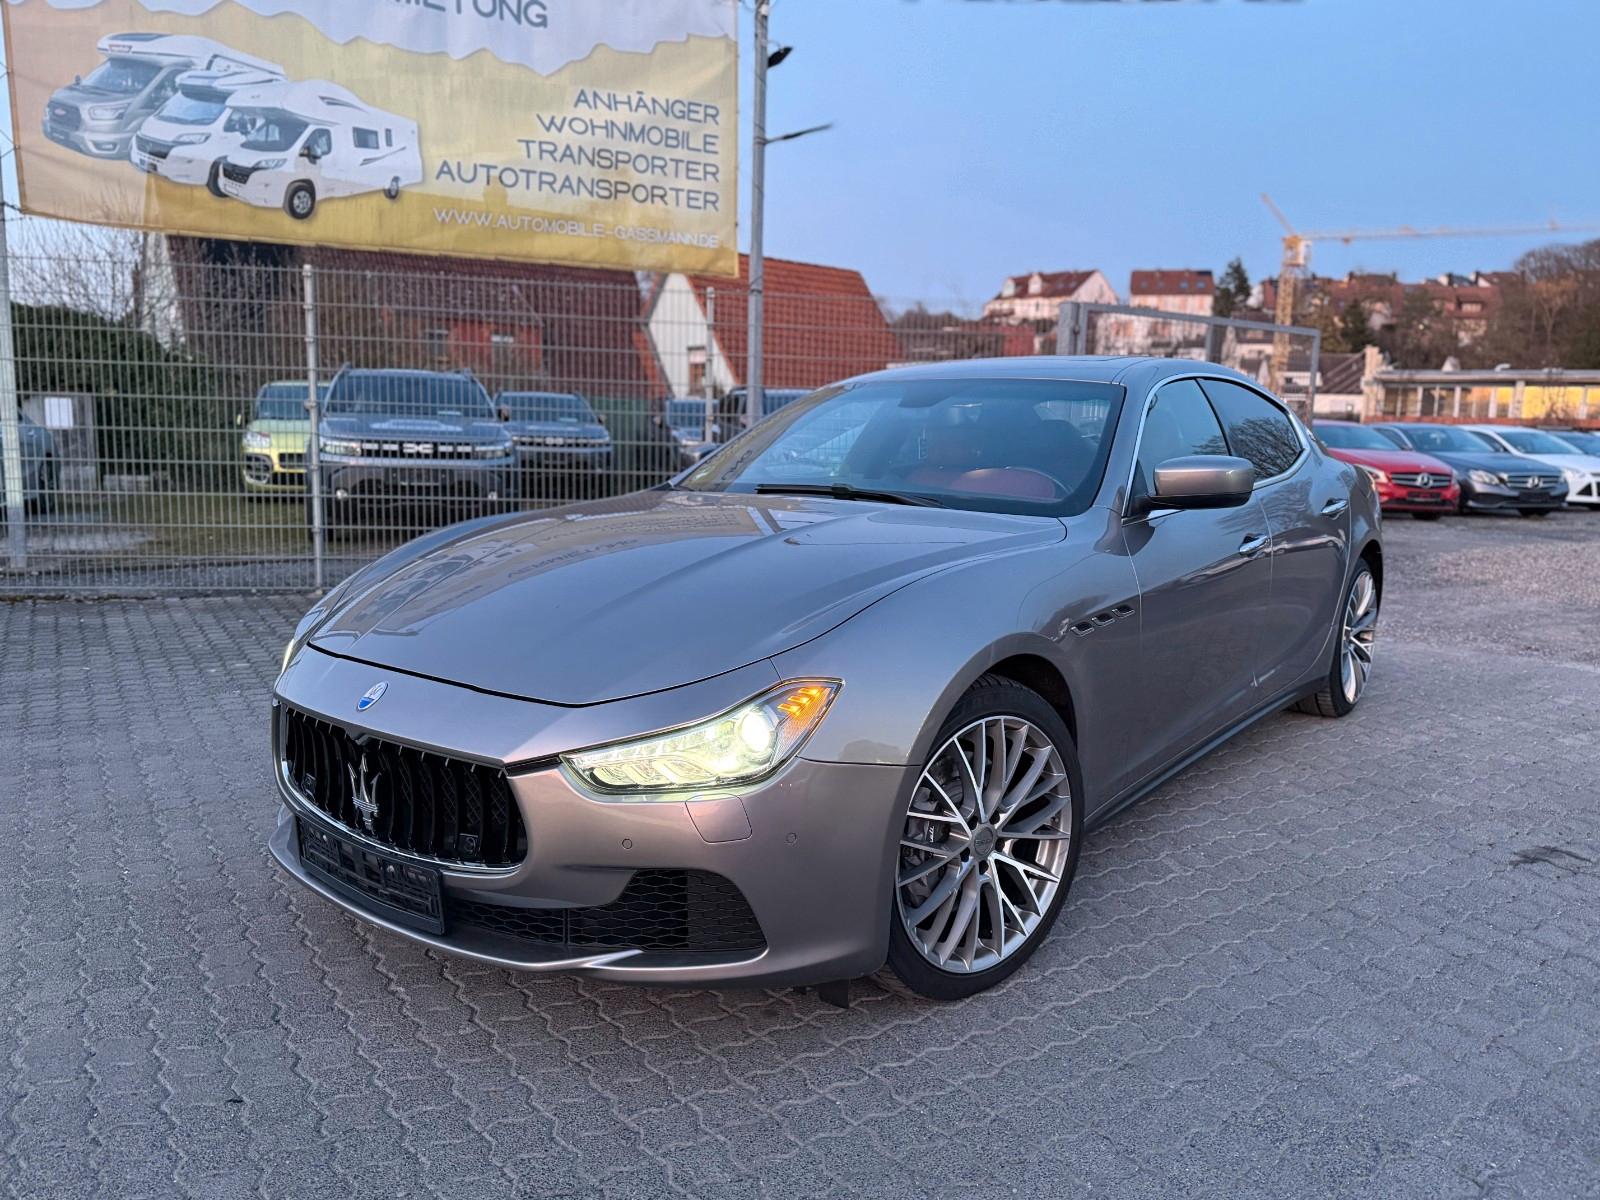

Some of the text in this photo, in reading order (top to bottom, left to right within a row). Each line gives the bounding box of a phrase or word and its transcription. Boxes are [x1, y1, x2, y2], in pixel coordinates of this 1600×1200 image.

[573, 88, 720, 126] ANHÄNGER
[536, 113, 720, 155] WOHNMOBILE
[517, 139, 720, 183] TRANSPORTER
[435, 160, 720, 212] AUTOTRANSPORTER
[432, 208, 721, 248] WWW.AUTOMOBILE-GASSMANN.DE
